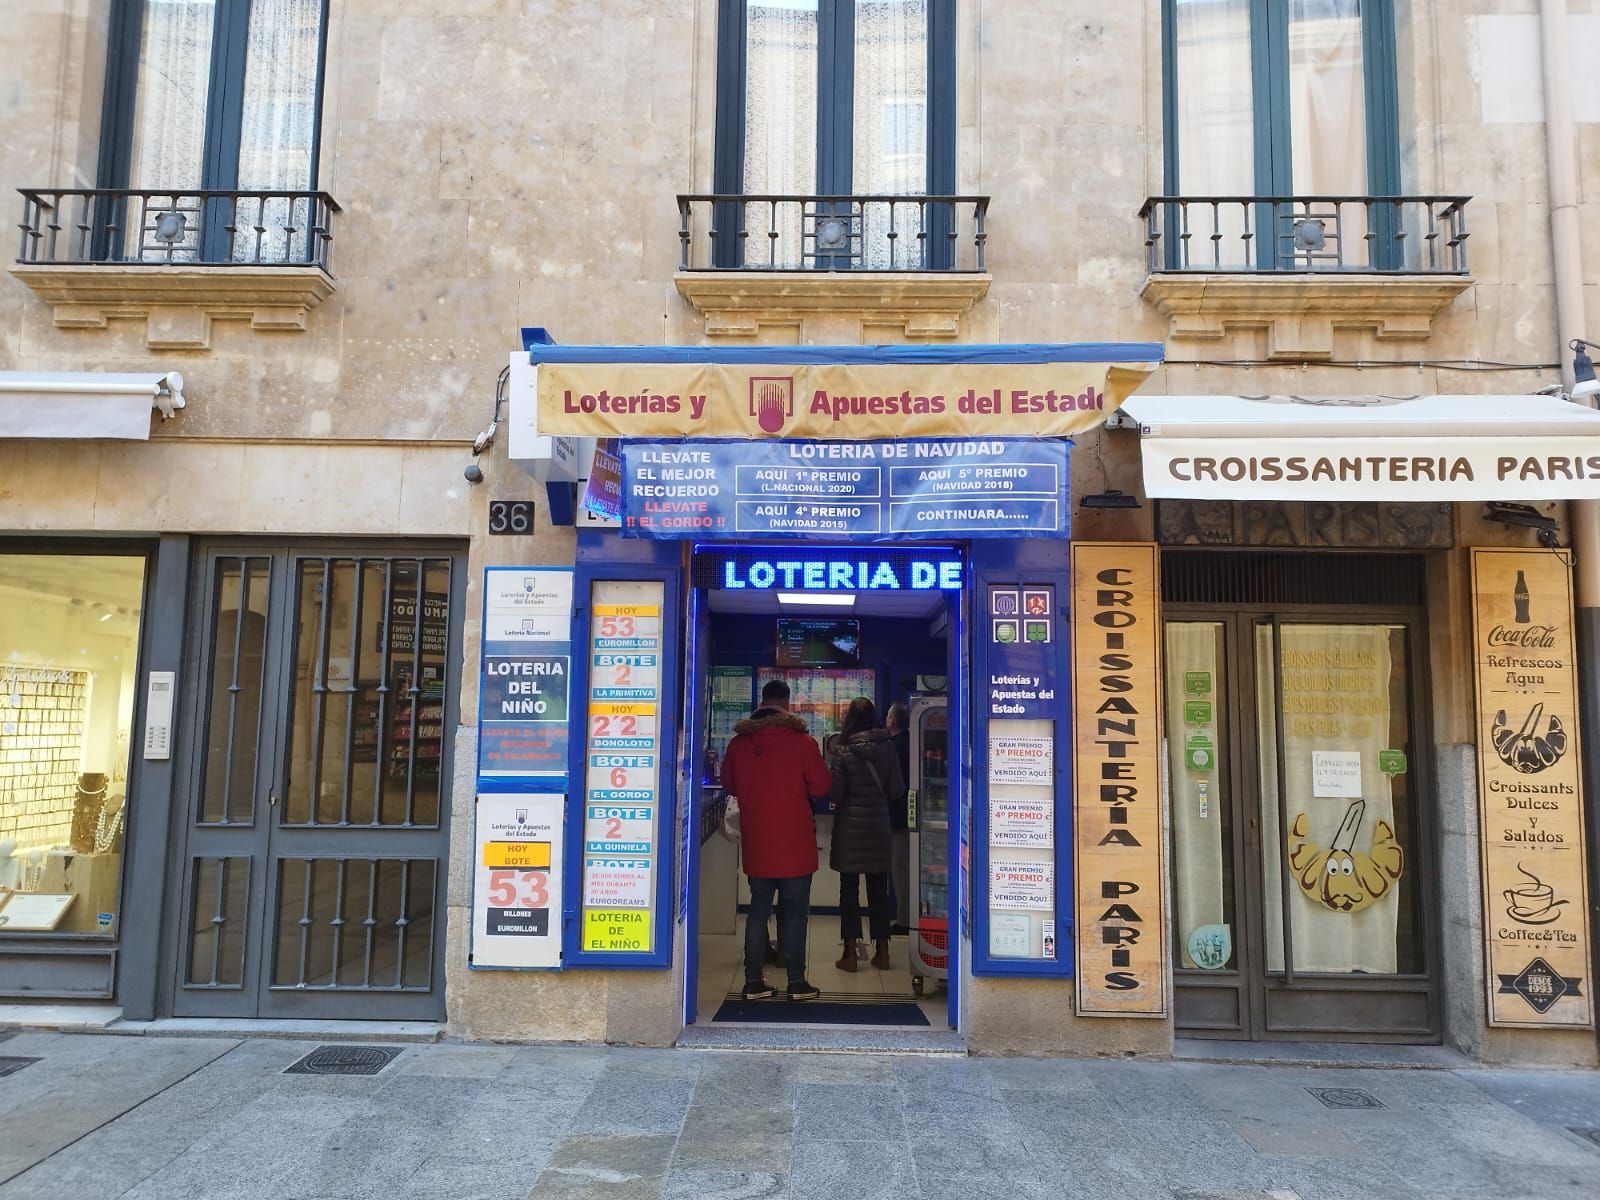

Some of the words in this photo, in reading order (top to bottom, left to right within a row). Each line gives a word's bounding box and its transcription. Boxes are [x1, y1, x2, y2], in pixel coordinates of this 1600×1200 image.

[564, 388, 681, 414] Loterías
[690, 395, 706, 420] y
[810, 390, 946, 420] Apuestas
[958, 389, 1002, 414] del
[790, 443, 875, 459] LOTERIA
[882, 444, 908, 458] DE
[914, 441, 1005, 458] NAVIDAD
[642, 451, 711, 464] LLEVATE
[637, 468, 656, 480] EL
[661, 468, 716, 481] MEJOR
[973, 468, 1028, 478] PREMIO
[1168, 456, 1474, 482] CROISSANTERIA
[812, 471, 861, 482] PREMIO
[633, 485, 720, 497] RECUERDO
[828, 484, 856, 494] 2020)
[932, 481, 981, 491] (NAVIDAD
[984, 480, 1014, 490] 2018)
[644, 501, 708, 513] LLEVATE
[812, 506, 861, 518] PREMIO
[490, 503, 528, 532] 36
[640, 516, 656, 528] EL
[664, 516, 713, 528] GORDO
[770, 519, 818, 529] (NAVIDAD
[819, 520, 848, 530] 2015)
[725, 560, 900, 588] LOTERIA
[911, 560, 962, 588] DE
[600, 616, 634, 638] 53
[1488, 624, 1558, 648] Coca-Cola
[600, 656, 652, 666] BOTE
[1487, 654, 1562, 668] Refrescos
[488, 662, 564, 676] LOTERIA
[614, 666, 631, 686] 2
[991, 675, 1031, 684] Loterías
[1033, 677, 1040, 687] y
[1506, 672, 1544, 687] Agua
[508, 682, 542, 694] DEL
[992, 690, 1036, 701] Apuestas
[1038, 690, 1054, 699] del
[502, 698, 547, 714] NIÑO
[992, 704, 1026, 714] Estado
[1007, 749, 1043, 757] PREMIO
[596, 756, 646, 766] BOTE
[610, 767, 627, 788] 6
[1489, 780, 1574, 794] Croissants
[610, 791, 650, 799] GORDO
[1506, 797, 1559, 810] Dulces
[594, 808, 648, 818] BOTE
[1008, 812, 1043, 820] PREMIO
[605, 818, 622, 839] 2
[1504, 829, 1564, 843] Salados
[508, 845, 528, 853] HOY
[504, 857, 530, 865] BOTE
[1008, 873, 1043, 882] PREMIO
[488, 871, 549, 908] 53
[590, 897, 645, 906] EURODREAMS
[590, 913, 642, 923] LOTERIA
[497, 925, 538, 933] EUROMILLON
[609, 926, 624, 935] DE
[1498, 928, 1577, 942] Coffee&Tea
[591, 940, 606, 948] EL
[609, 938, 641, 949] NIÑO
